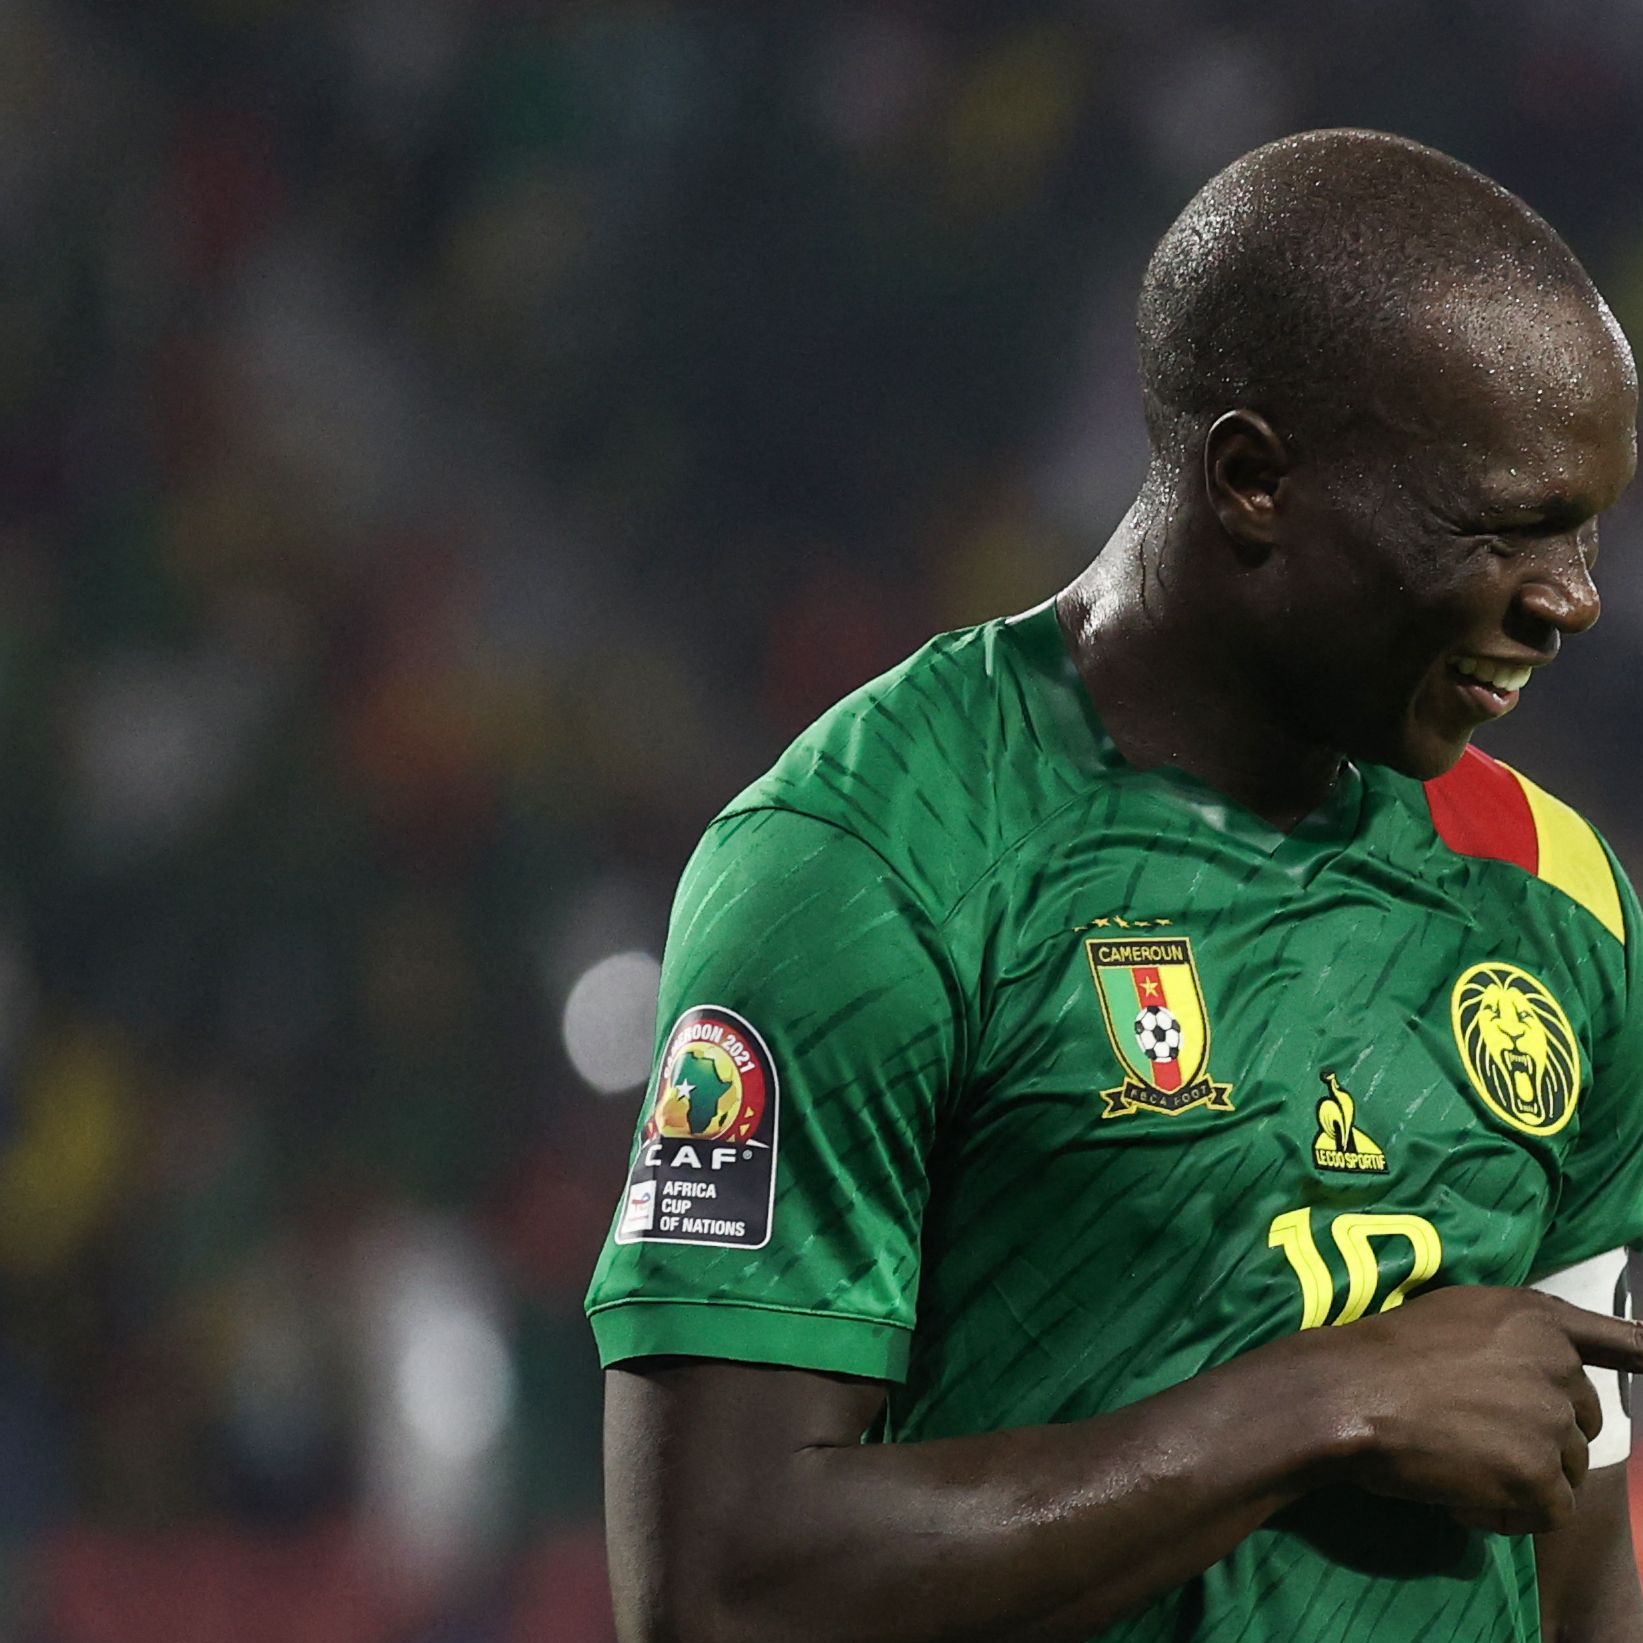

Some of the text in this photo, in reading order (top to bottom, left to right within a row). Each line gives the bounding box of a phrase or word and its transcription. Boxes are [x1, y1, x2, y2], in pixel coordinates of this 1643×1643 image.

[1099, 945, 1184, 962] CAMEROUN
[722, 1034, 755, 1073] 2021
[644, 1144, 736, 1170] CAF
[663, 1181, 717, 1198] AFRICA
[662, 1199, 692, 1214] CUP
[660, 1216, 745, 1236] OF NATIONS
